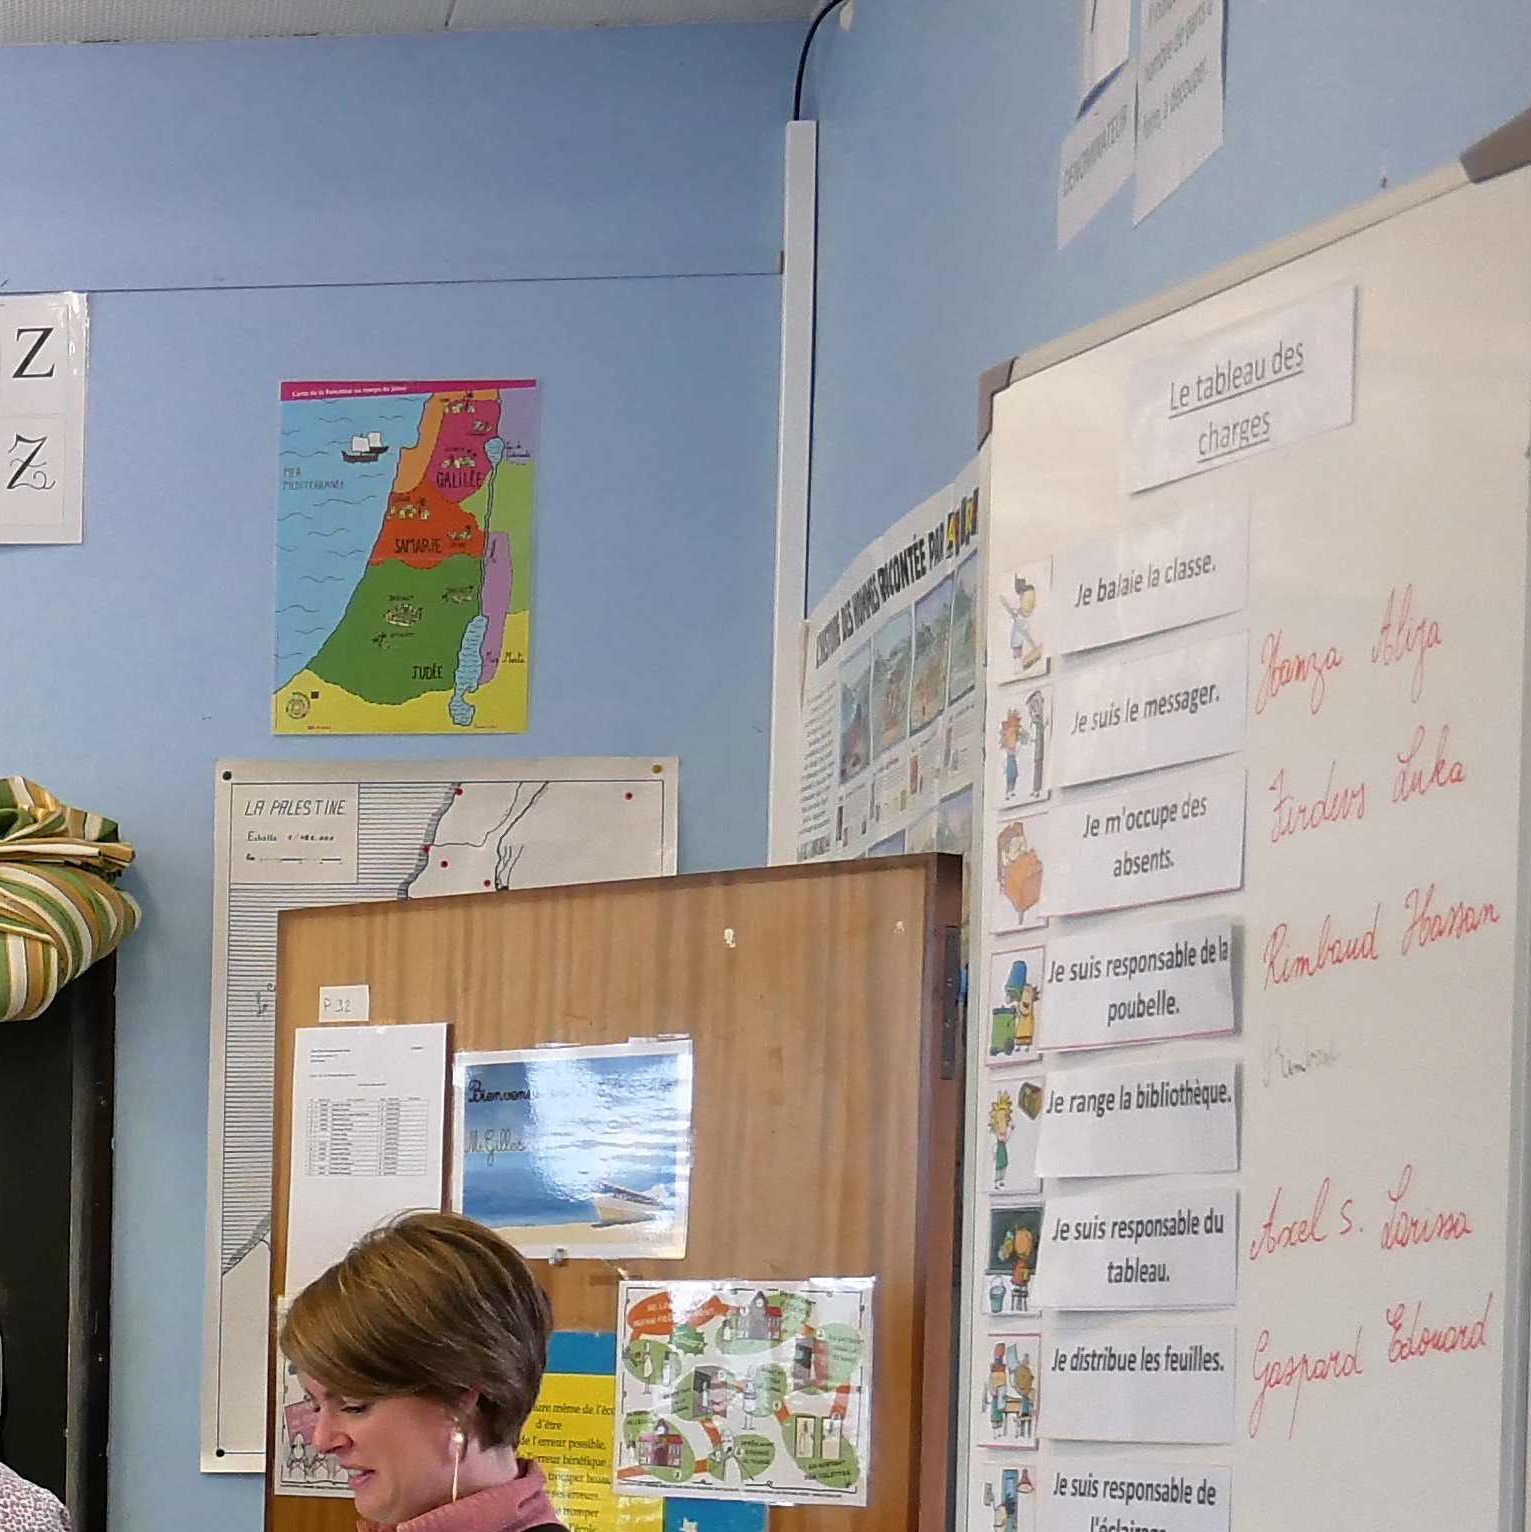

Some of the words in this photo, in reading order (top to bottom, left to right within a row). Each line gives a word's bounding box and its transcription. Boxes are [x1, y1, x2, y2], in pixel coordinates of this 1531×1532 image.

[1170, 379, 1189, 411] Le
[1196, 358, 1266, 402] tableau
[1272, 340, 1304, 374] des
[1198, 410, 1270, 455] charges
[394, 538, 442, 554] SAMARIE
[1075, 583, 1092, 608] Je
[1097, 571, 1143, 603] balaie
[1147, 563, 1160, 588] la
[1164, 553, 1216, 584] classe.
[411, 665, 443, 681] JUDÉE
[1071, 711, 1087, 735] Je
[1091, 702, 1121, 731] suis
[1125, 697, 1139, 722] le
[1143, 684, 1220, 719] messager.
[1392, 724, 1465, 803] Luka
[244, 799, 265, 816] LA
[269, 799, 346, 816] PALESTINE
[1083, 814, 1100, 838] Je
[1105, 804, 1177, 835] m'occupe
[1181, 792, 1207, 819] des
[1113, 848, 1174, 878] absents.
[1048, 960, 1065, 983] Je
[1069, 955, 1102, 982] suis
[1106, 941, 1197, 981] responsable
[1200, 937, 1216, 965] de
[1218, 935, 1229, 962] la
[1263, 903, 1380, 991] Rimbaud
[1107, 989, 1180, 1027] poubelle.
[1046, 1090, 1064, 1114] Je
[1069, 1092, 1115, 1118] range
[1119, 1085, 1132, 1110] la
[1136, 1079, 1232, 1110] bibliothèque.
[1052, 1218, 1070, 1242] Je
[1074, 1215, 1106, 1240] suis
[1110, 1208, 1200, 1244] responsable
[1204, 1207, 1224, 1234] du
[1249, 1176, 1329, 1260] Axel
[1381, 1163, 1472, 1250] Larissa
[1107, 1257, 1170, 1284] tableau.
[1051, 1348, 1067, 1372] Je
[1070, 1346, 1137, 1372] distribue
[1140, 1346, 1160, 1372] les
[1164, 1345, 1225, 1372] feuilles.
[1248, 1324, 1363, 1440] Gaspard
[1386, 1292, 1493, 1363] Edouard
[1053, 1472, 1068, 1496] Je
[1070, 1473, 1099, 1498] suis
[1103, 1476, 1193, 1506] responsable
[1196, 1478, 1217, 1505] de
